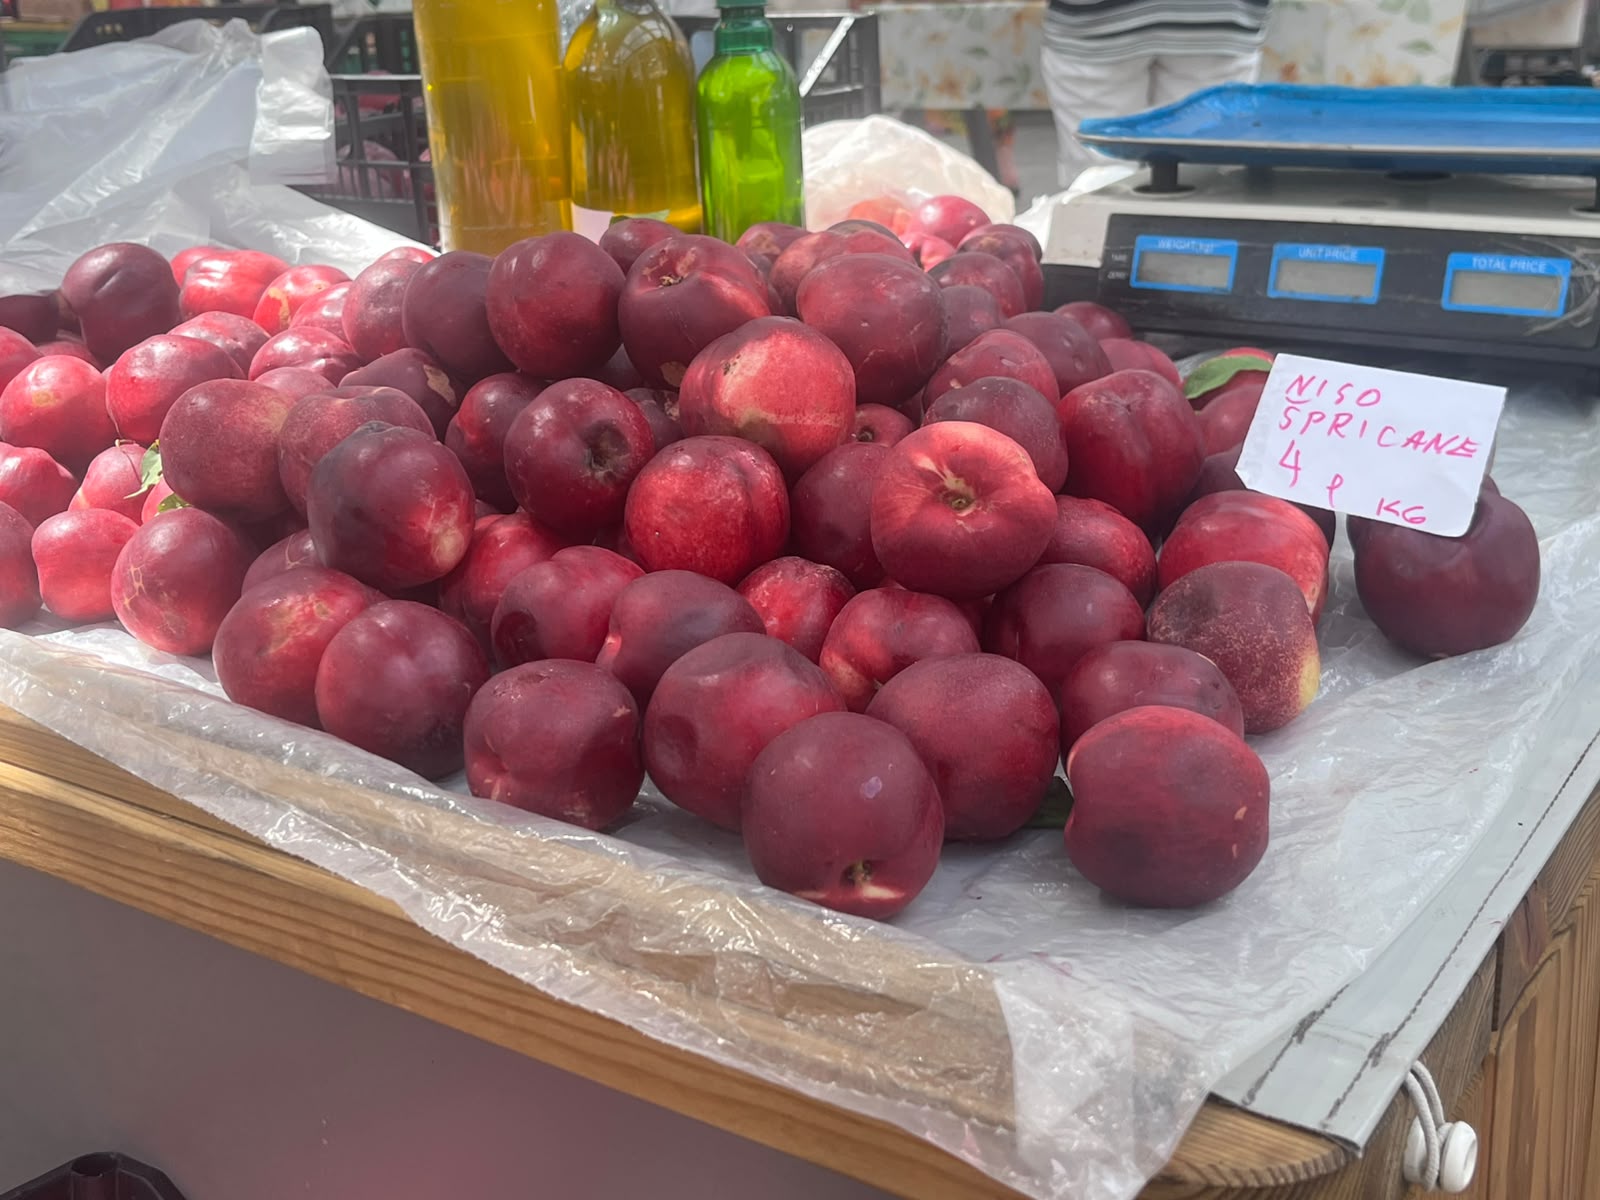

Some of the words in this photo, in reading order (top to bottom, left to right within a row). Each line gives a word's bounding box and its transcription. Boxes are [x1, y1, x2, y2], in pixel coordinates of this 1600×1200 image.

[1298, 247, 1323, 259] UNIT
[1324, 249, 1359, 262] PRICE
[1472, 256, 1506, 270] TOTAL
[1509, 259, 1547, 273] PRICE
[1285, 374, 1381, 407] NISO
[1278, 439, 1302, 488] 4
[1376, 497, 1427, 525] KG
